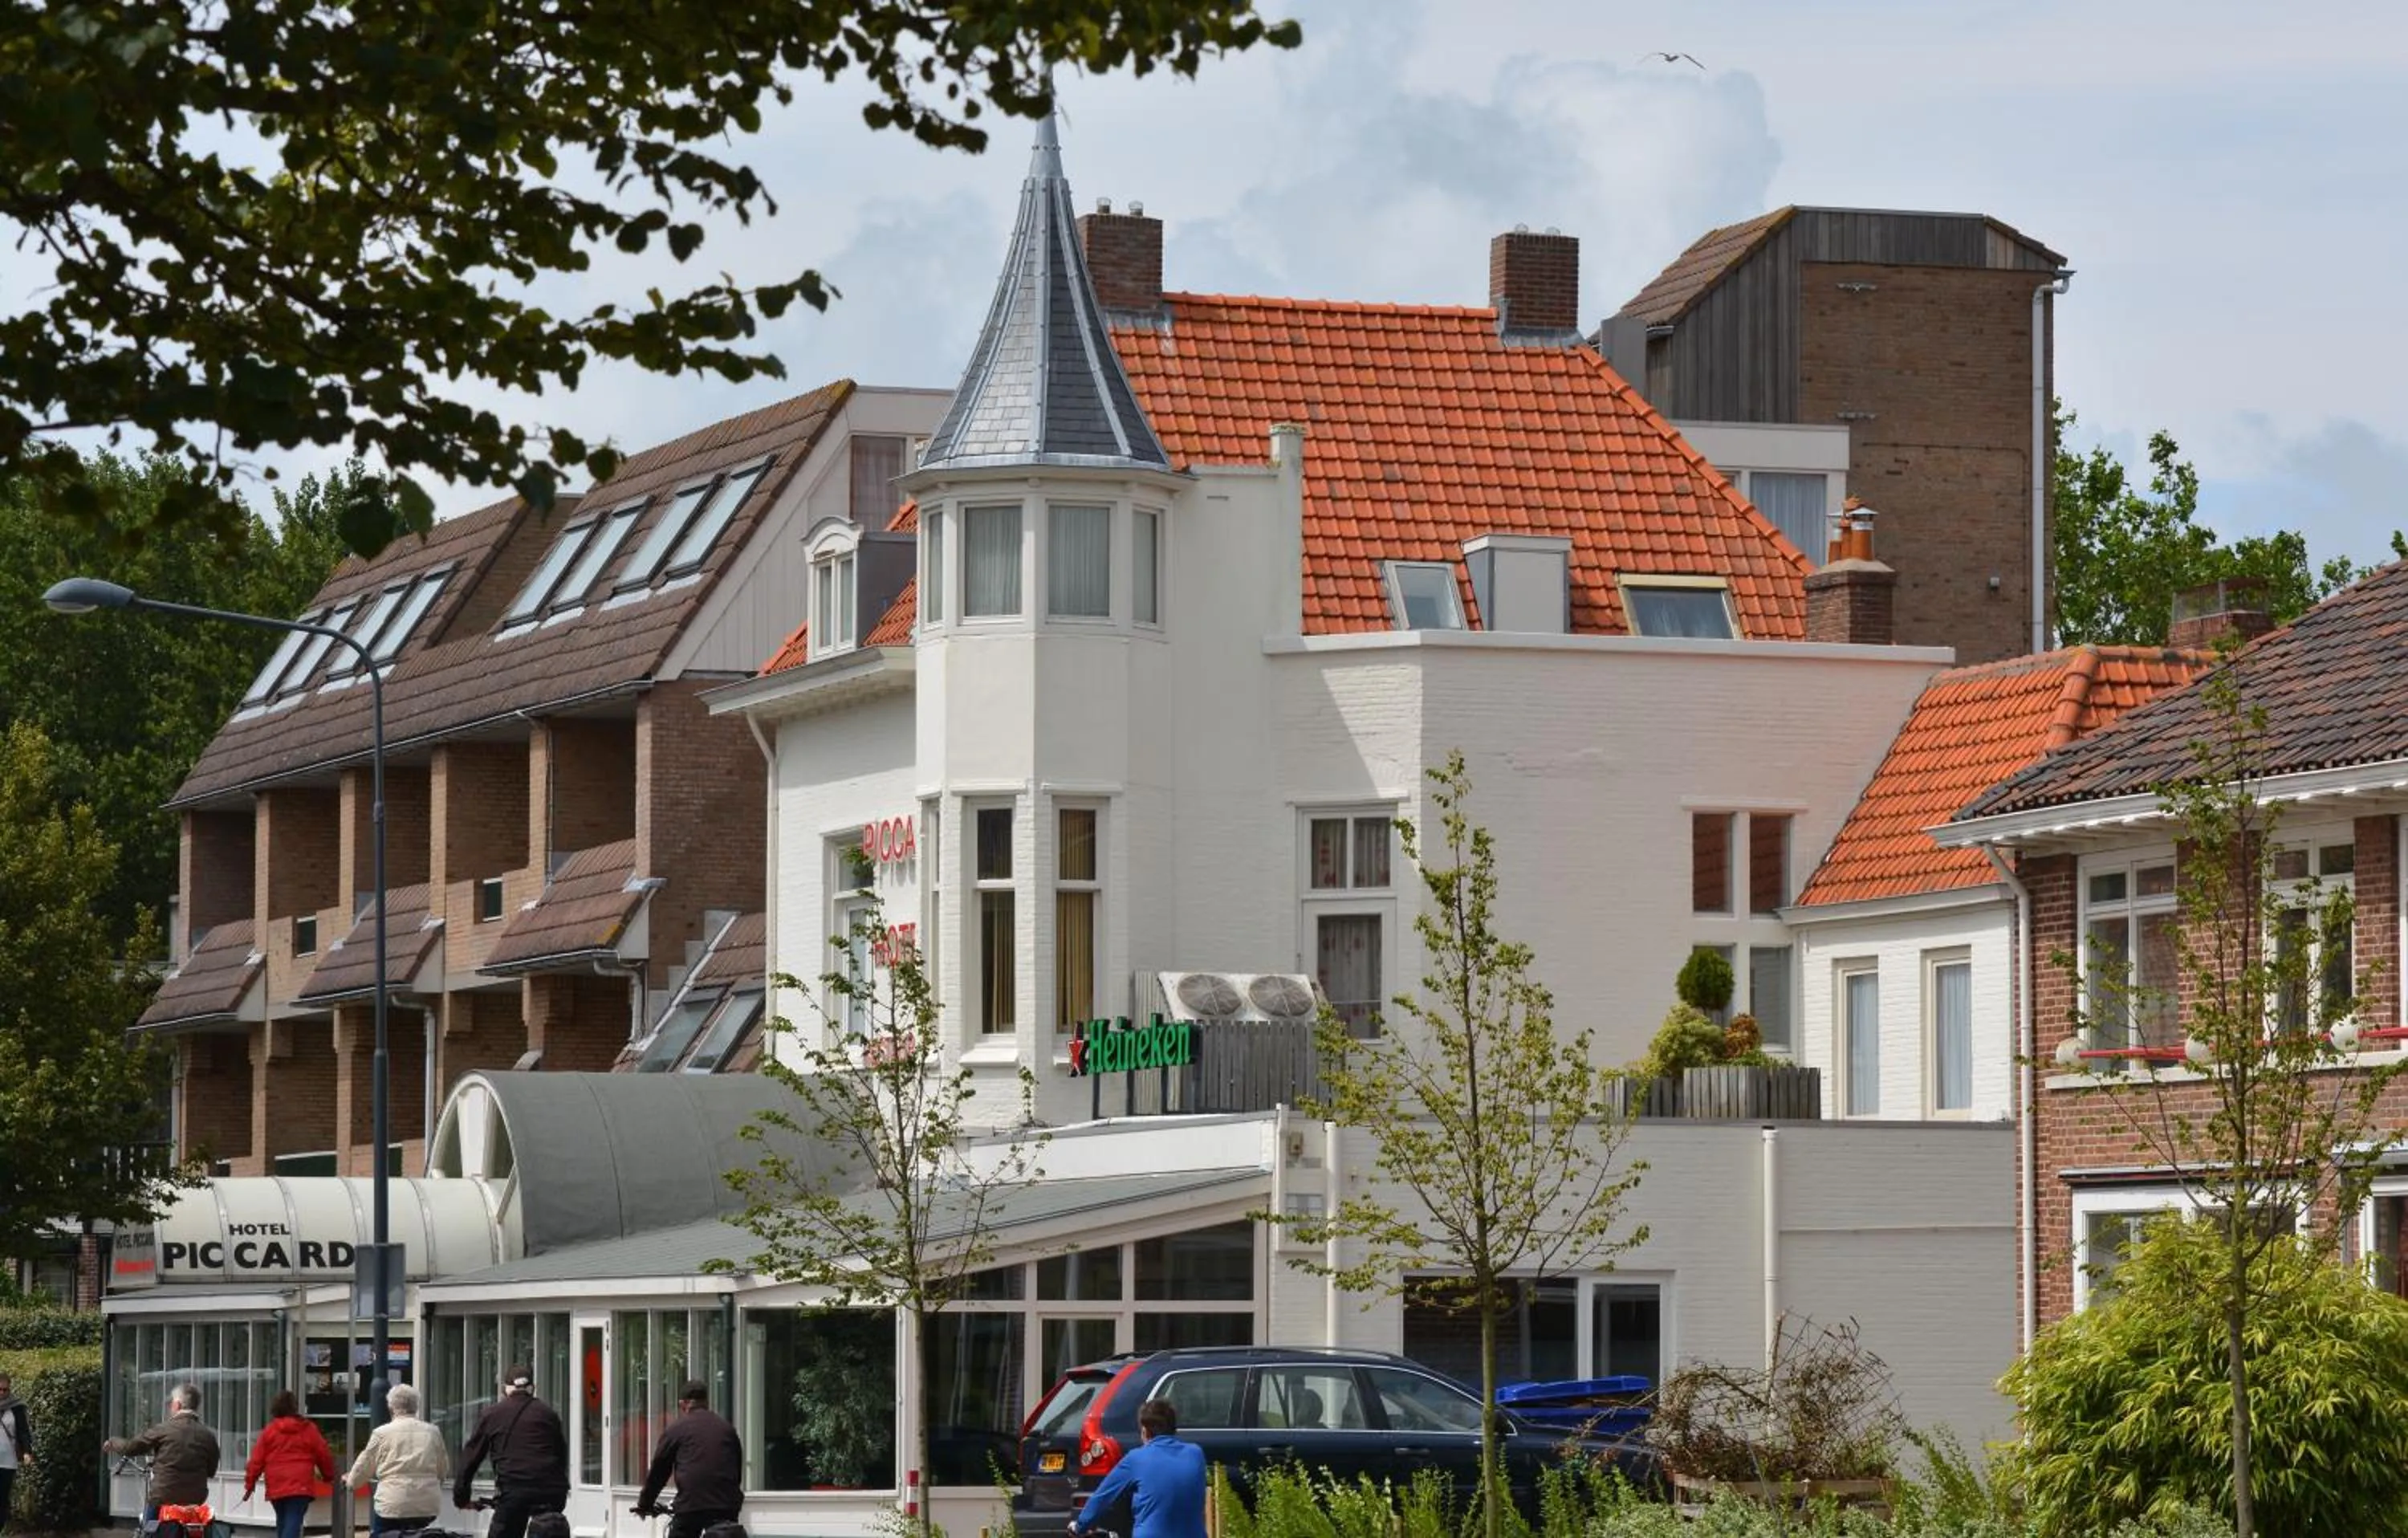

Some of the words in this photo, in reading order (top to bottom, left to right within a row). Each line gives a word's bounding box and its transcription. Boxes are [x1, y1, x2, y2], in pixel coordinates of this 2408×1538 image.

[1087, 1012, 1194, 1075] Heineken
[229, 1223, 291, 1236] HOTEL
[162, 1241, 356, 1269] PICCARD
